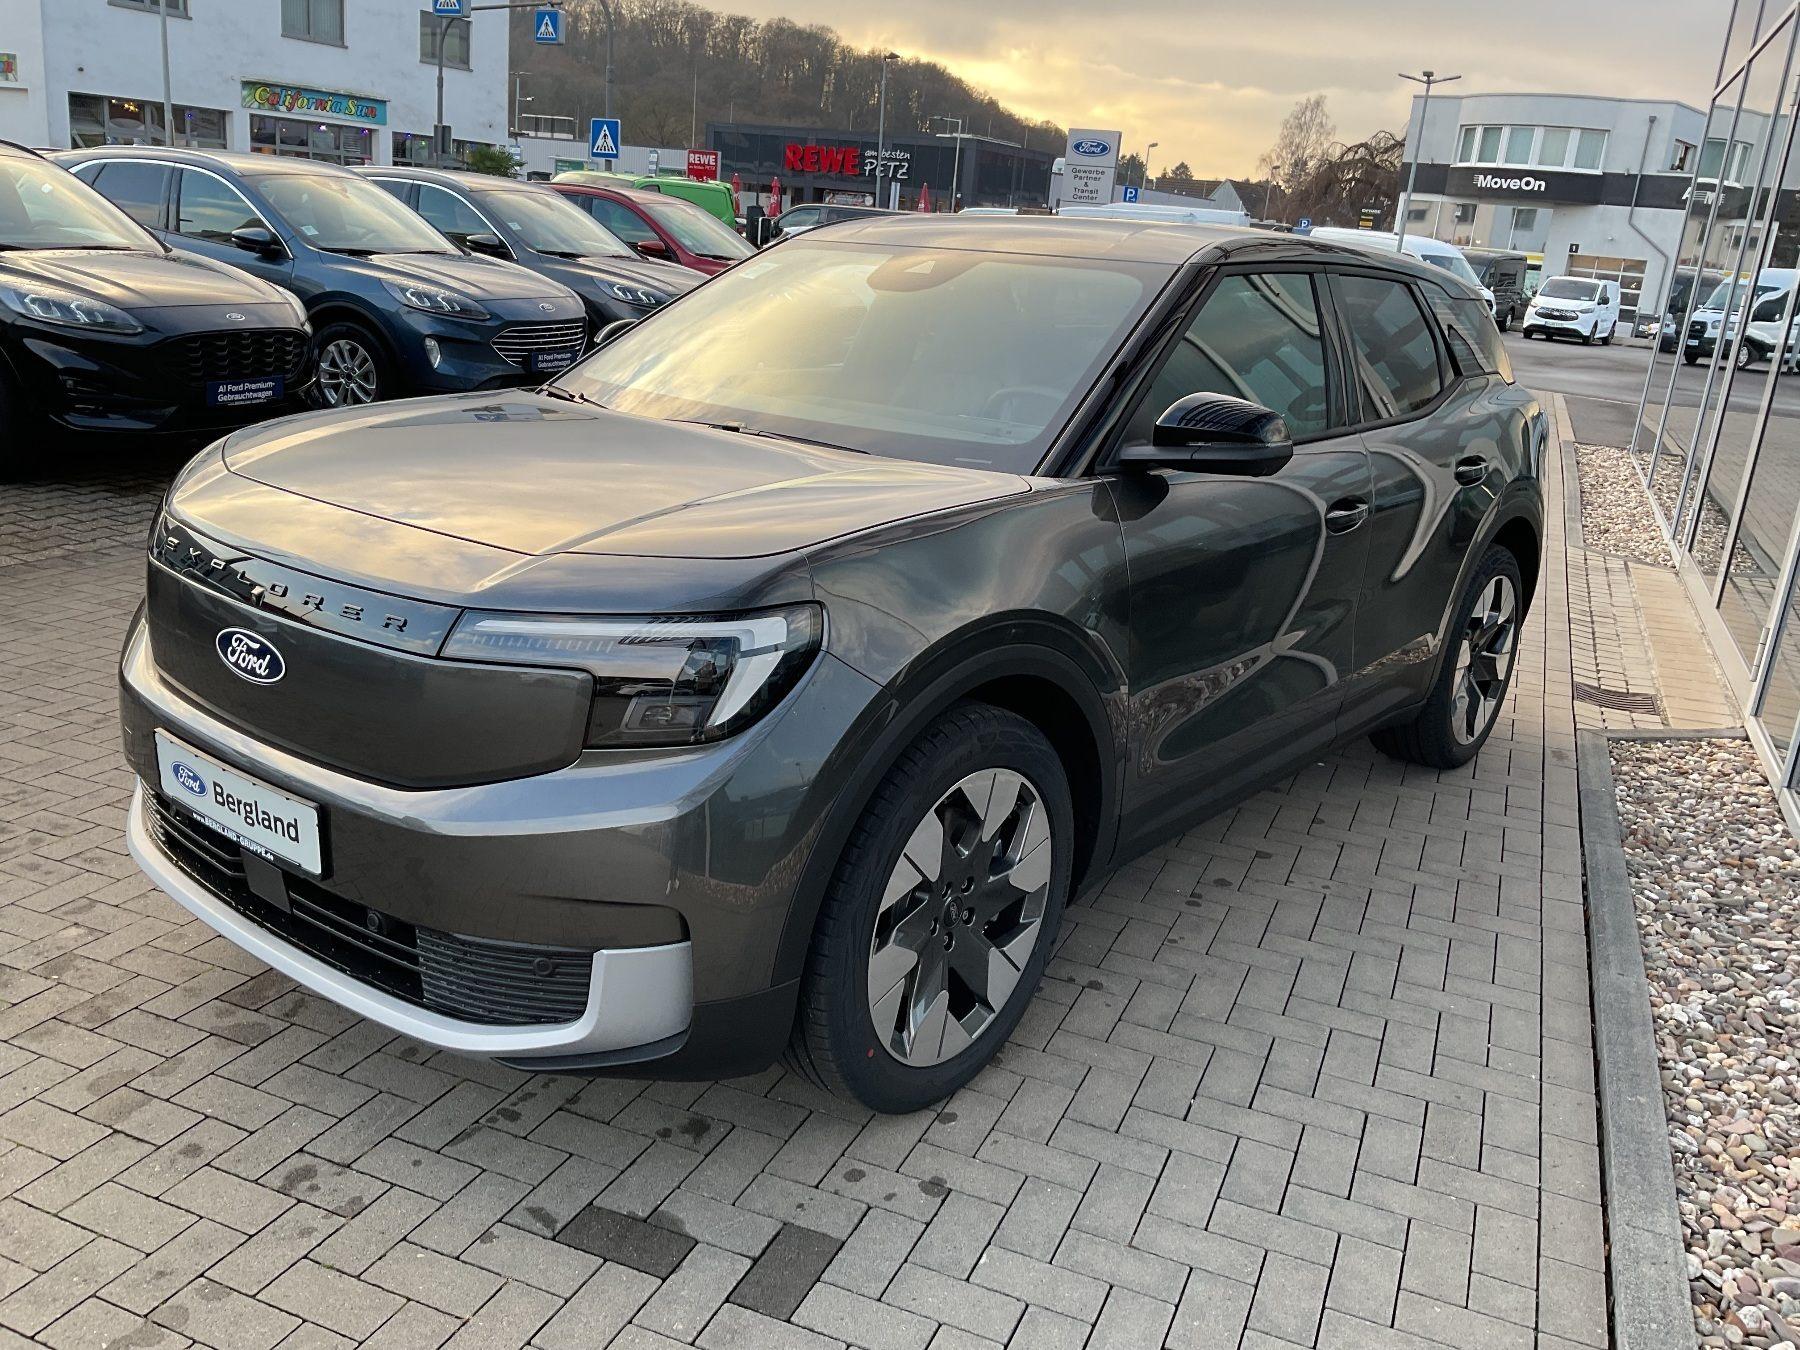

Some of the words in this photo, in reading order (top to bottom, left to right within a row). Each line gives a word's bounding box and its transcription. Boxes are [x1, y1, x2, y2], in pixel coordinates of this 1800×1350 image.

[254, 86, 342, 113] California
[344, 99, 377, 118] Sun
[688, 153, 716, 165] REWE
[785, 144, 860, 175] REWE
[864, 149, 878, 157] am
[881, 148, 910, 159] besten
[863, 159, 909, 179] PETZ
[1071, 167, 1106, 175] Gewerbe
[1477, 174, 1546, 191] MoveOn
[227, 383, 243, 391] Ford
[244, 381, 275, 390] Premium-
[217, 390, 273, 402] Gebrauchtwagen
[227, 633, 271, 676] Ford
[177, 764, 201, 793] Ford
[212, 780, 300, 844] Bergland
